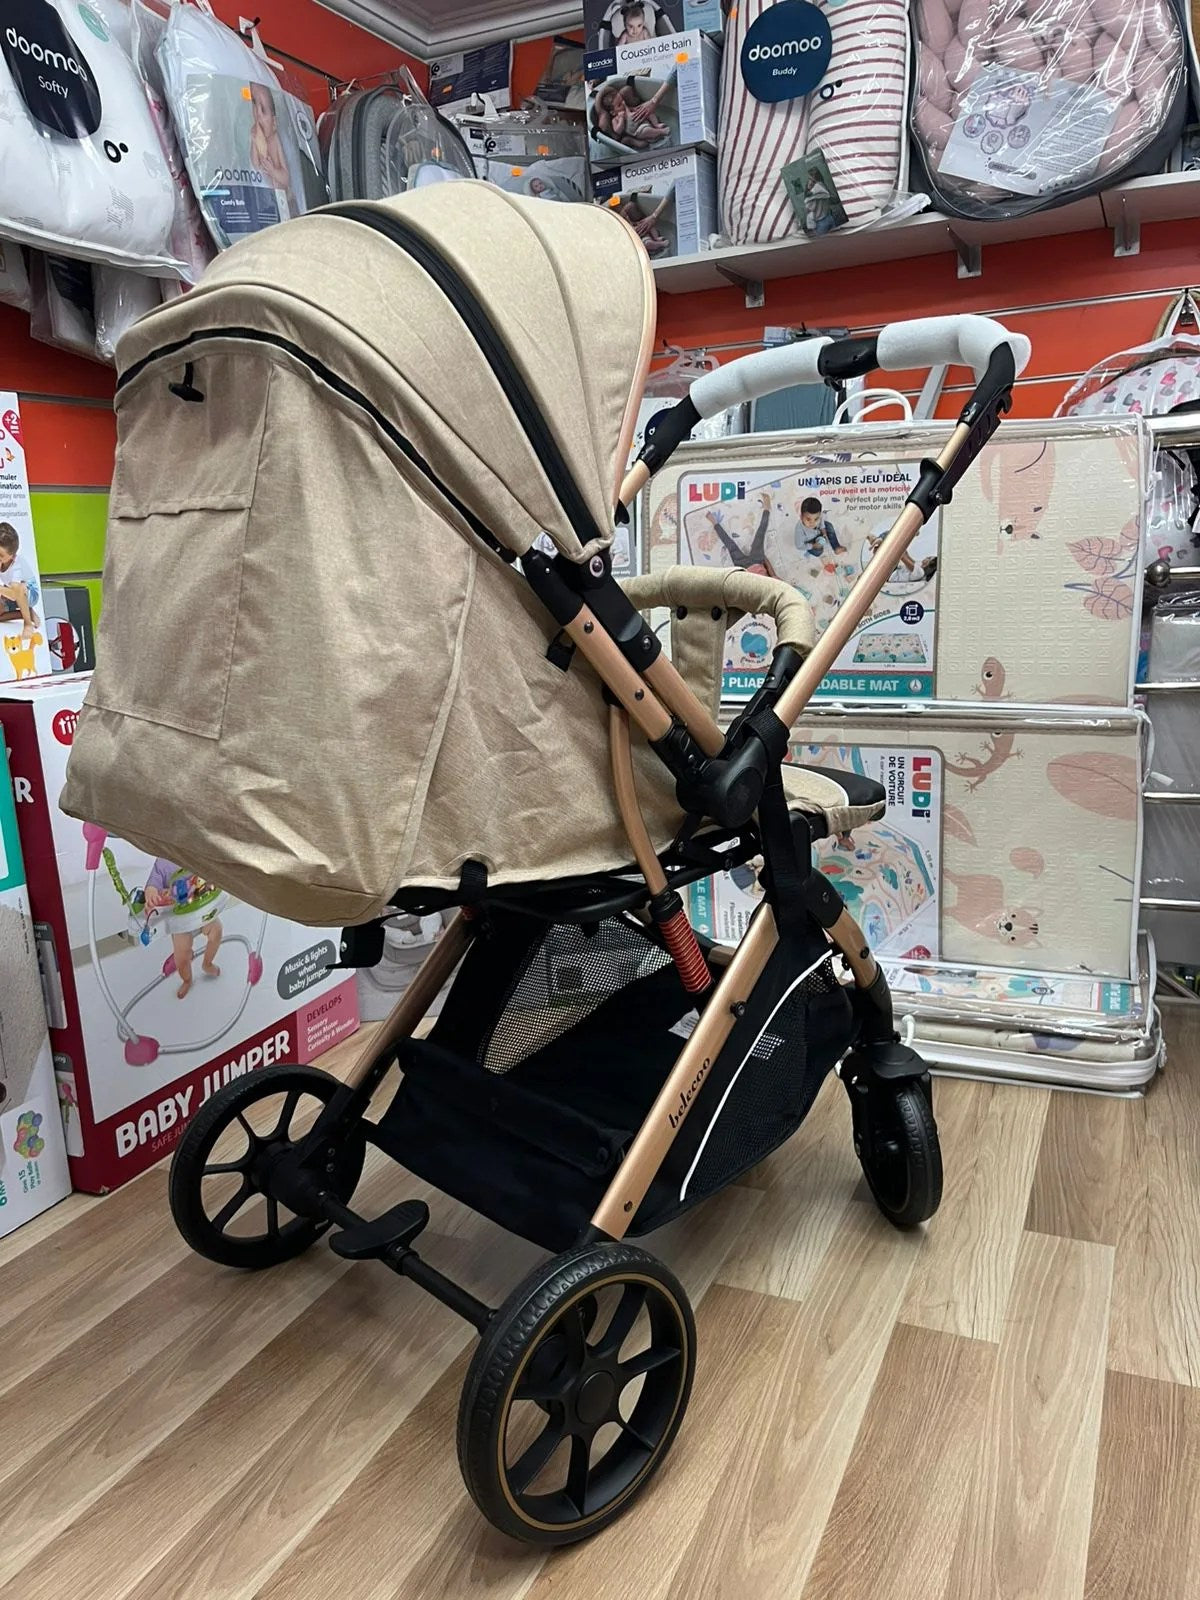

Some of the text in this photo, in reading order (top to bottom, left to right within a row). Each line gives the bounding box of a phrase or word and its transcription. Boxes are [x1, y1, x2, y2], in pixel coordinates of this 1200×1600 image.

[6, 27, 88, 81] doomoo
[620, 37, 692, 60] Coussin de bain
[748, 36, 822, 61] doomoo
[772, 66, 798, 76] Buddy
[38, 75, 68, 99] Softy
[215, 166, 262, 183] doomoo
[625, 156, 688, 178] Coussin de bain
[798, 472, 912, 486] UN TAPIS DE JEU IDÉAL
[820, 488, 836, 496] pour
[877, 485, 911, 493] motricité
[873, 495, 888, 503] play
[729, 677, 765, 688] PLIAB
[817, 679, 866, 690] DABLE
[869, 680, 899, 691] MAT
[888, 756, 896, 806] DE VOITURE
[897, 757, 905, 806] UN CIRCUIT
[697, 896, 707, 918] MAT
[284, 945, 328, 975] Music & lights
[298, 962, 317, 977] when
[288, 977, 307, 994] baby
[306, 994, 342, 1023] DEVELOPS
[307, 1017, 329, 1035] Sensory
[307, 1019, 339, 1043] Gross Motor
[307, 1033, 331, 1052] Curiosity
[115, 1030, 291, 1159] BABY JUMPER
[151, 1131, 173, 1153] SAFE
[18, 1170, 26, 1180] 15
